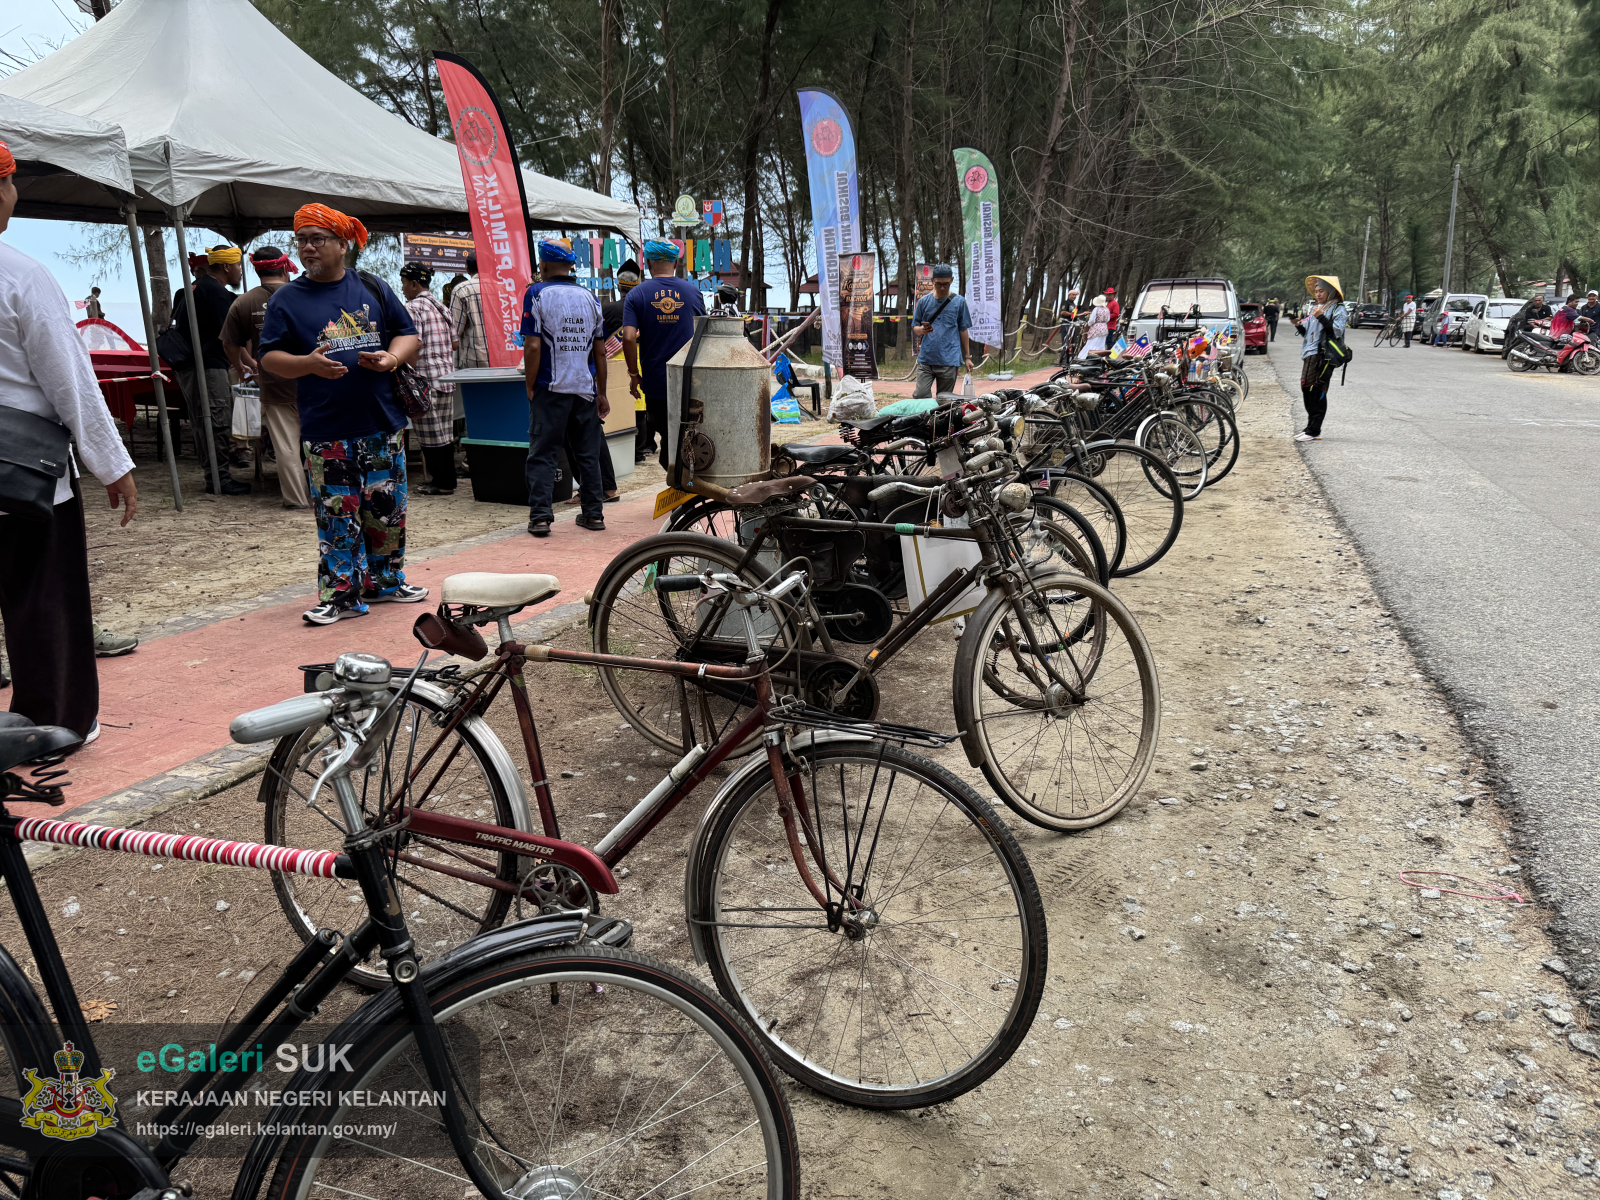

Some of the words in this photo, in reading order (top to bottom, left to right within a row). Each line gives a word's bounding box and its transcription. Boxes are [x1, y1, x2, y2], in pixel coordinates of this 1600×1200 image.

[564, 317, 584, 325] KELAB
[475, 832, 512, 847] TRAFFIC
[512, 840, 555, 856] MASTER
